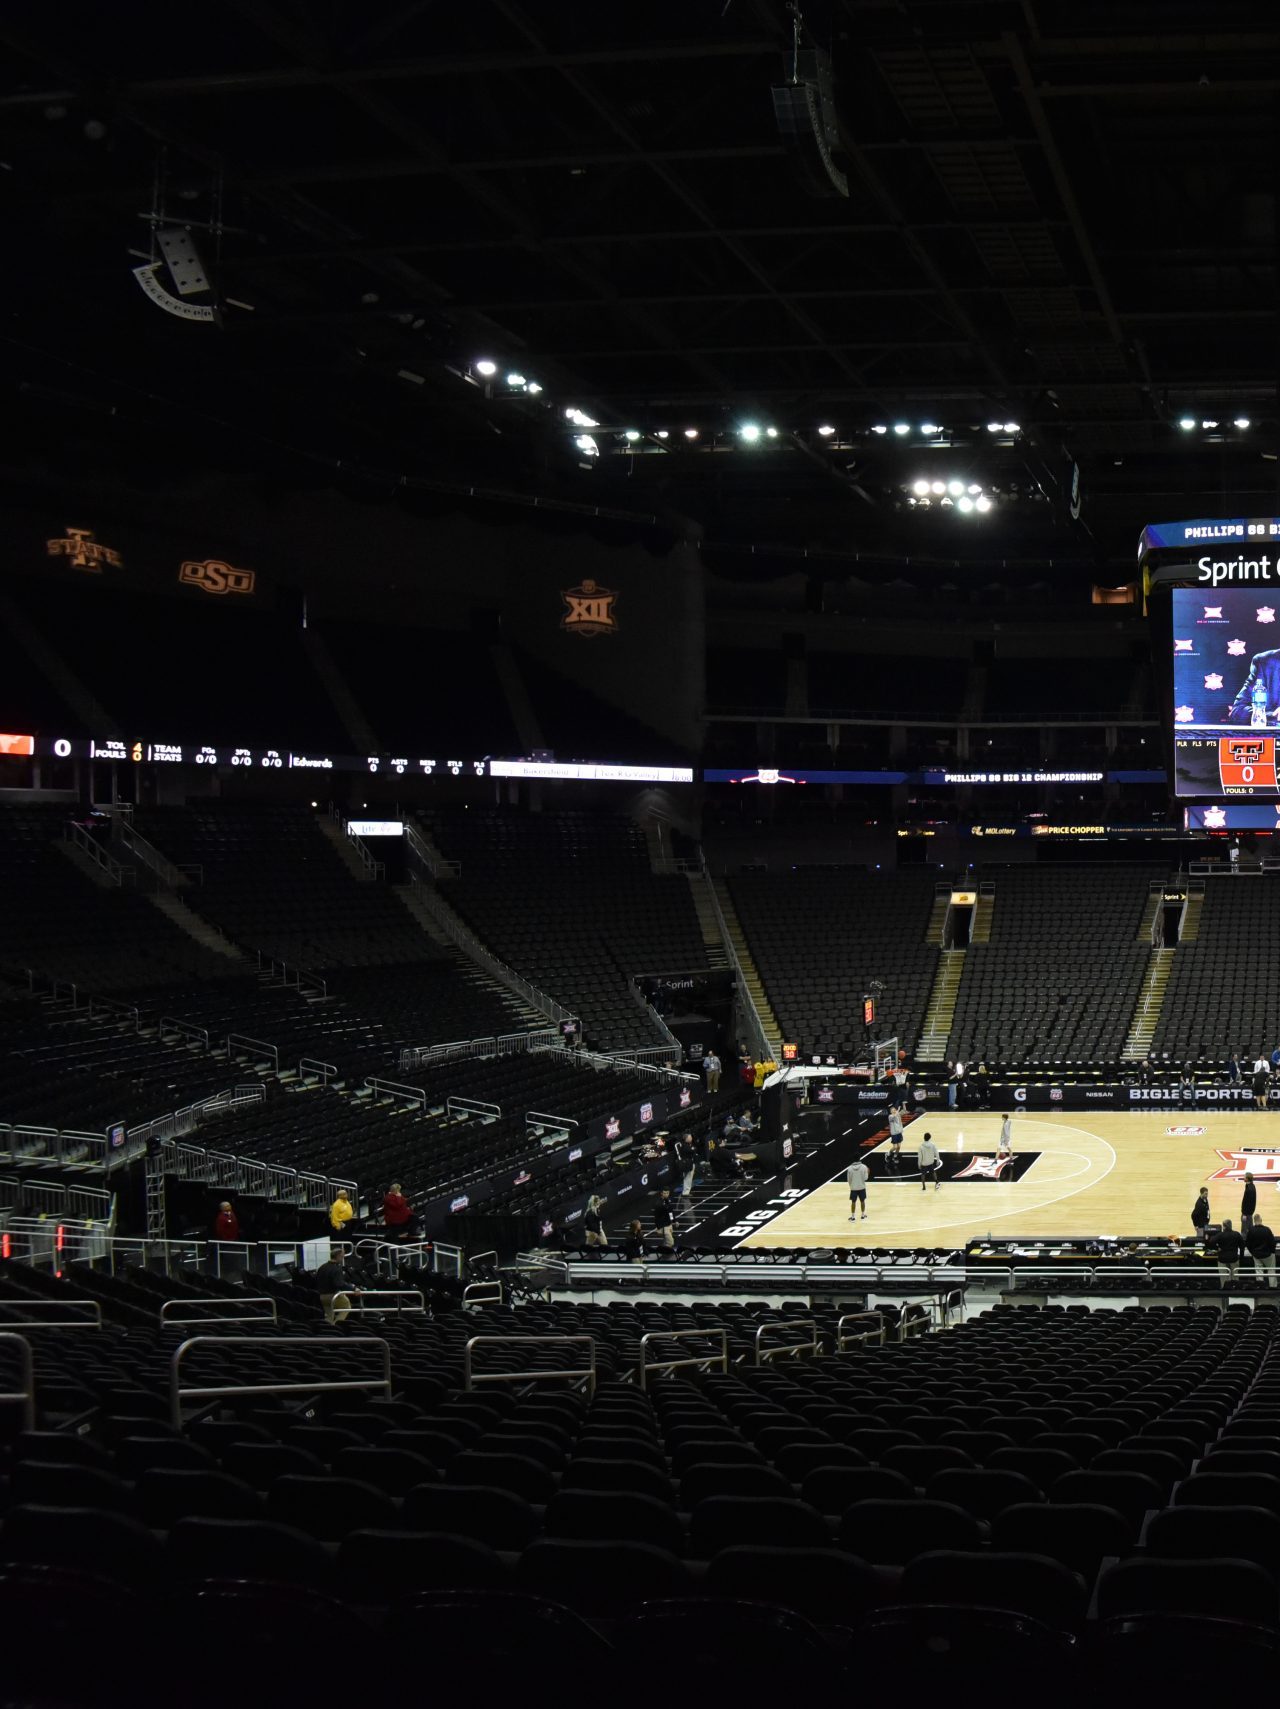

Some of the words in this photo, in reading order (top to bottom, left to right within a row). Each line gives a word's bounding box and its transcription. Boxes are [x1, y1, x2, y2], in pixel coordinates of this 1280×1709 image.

[1185, 526, 1243, 538] PHILLIPS
[1248, 524, 1264, 535] 66
[1198, 555, 1271, 586] Sprint
[184, 562, 250, 591] OSU
[564, 595, 615, 625] XII
[54, 739, 71, 757] 0
[106, 741, 126, 750] TOL
[133, 742, 142, 752] 4
[154, 744, 182, 754] TEAM
[95, 750, 127, 759] FOULS
[132, 751, 142, 761] 0
[154, 753, 182, 762] STATS
[195, 754, 217, 765] 0/0
[231, 756, 252, 766] 0/0
[262, 758, 282, 768] 0/0
[293, 755, 332, 769] Edwards
[370, 764, 377, 772] 0
[396, 765, 404, 774] 0
[424, 766, 432, 774] 0
[452, 766, 459, 775] 0
[476, 767, 483, 776] 0
[944, 774, 986, 782] PHILLIPS
[1003, 773, 1020, 782] BIG
[1021, 773, 1032, 782] 12
[1034, 772, 1104, 781] CHAMPIONSHIP
[1242, 766, 1254, 782] 0
[1048, 826, 1070, 834] PRICE
[1070, 826, 1105, 834] CHOPPER
[1014, 1088, 1027, 1101] G
[641, 1174, 648, 1186] G
[766, 1188, 810, 1205] 12
[718, 1210, 779, 1237] BIG
